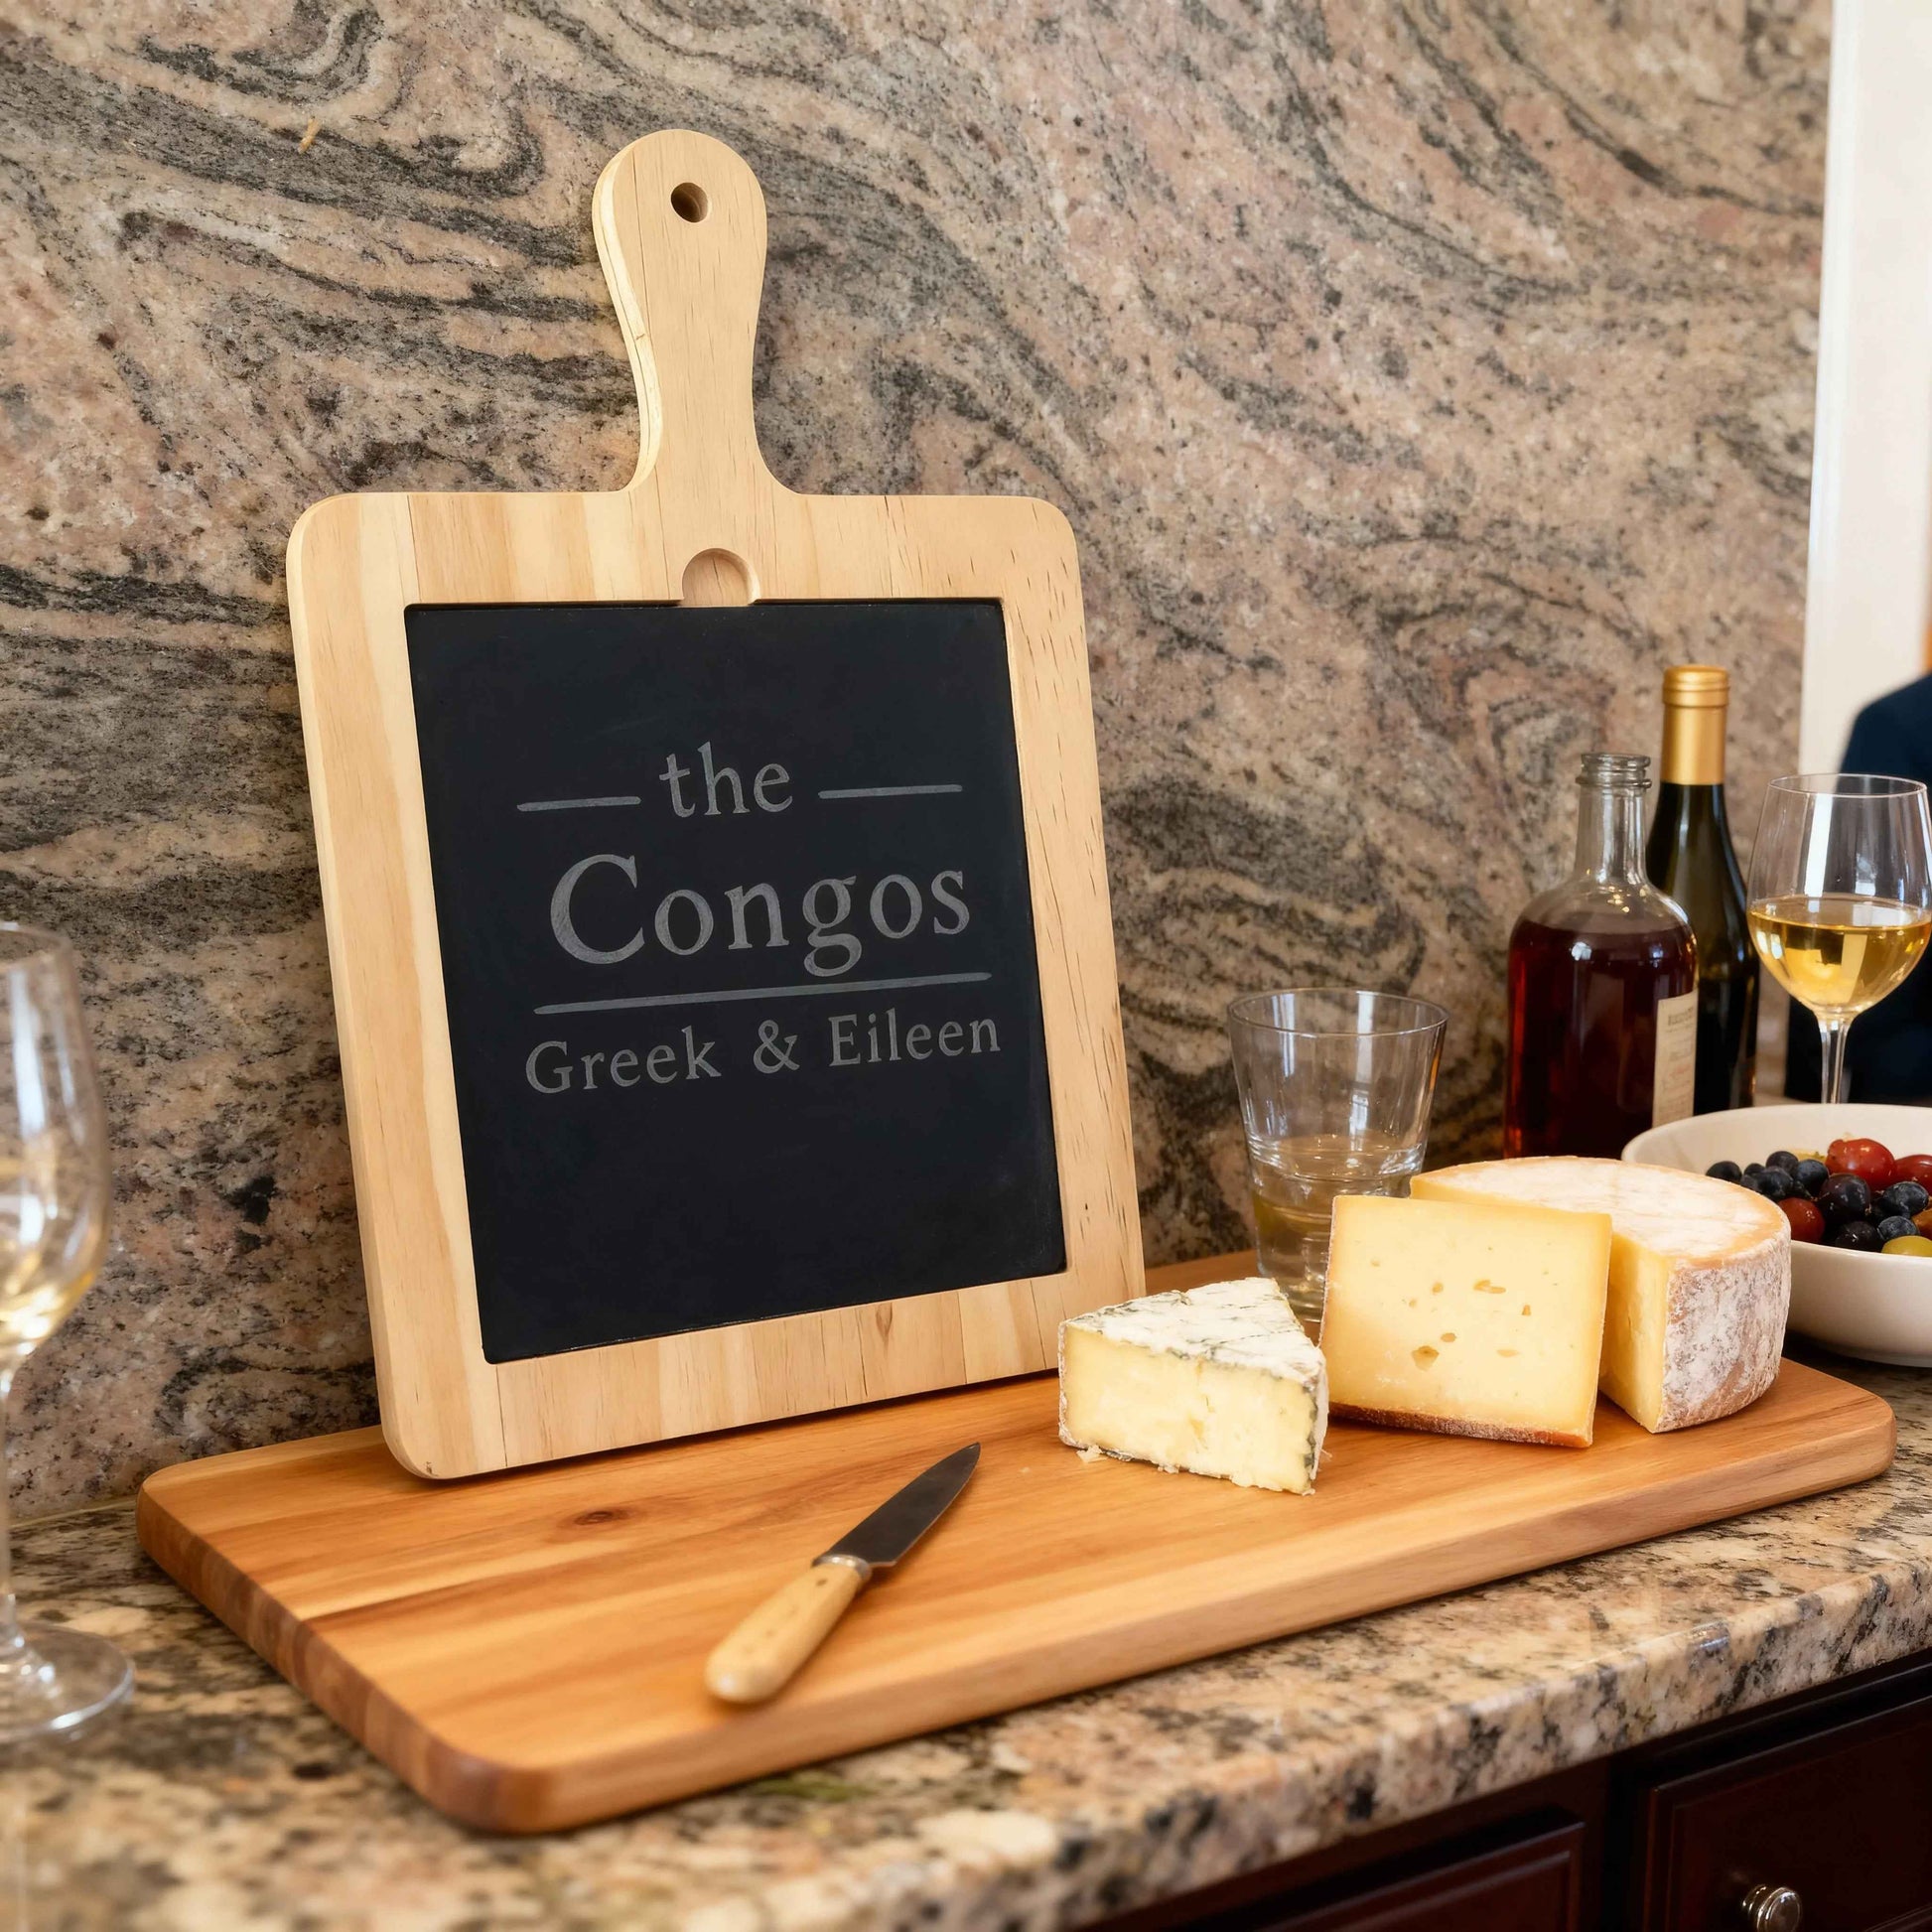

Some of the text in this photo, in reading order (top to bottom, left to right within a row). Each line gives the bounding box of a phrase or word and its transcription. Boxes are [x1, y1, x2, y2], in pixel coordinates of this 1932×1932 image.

[659, 742, 792, 817] the
[551, 854, 969, 977] Congos
[526, 1008, 1001, 1093] Greek & Eileen
